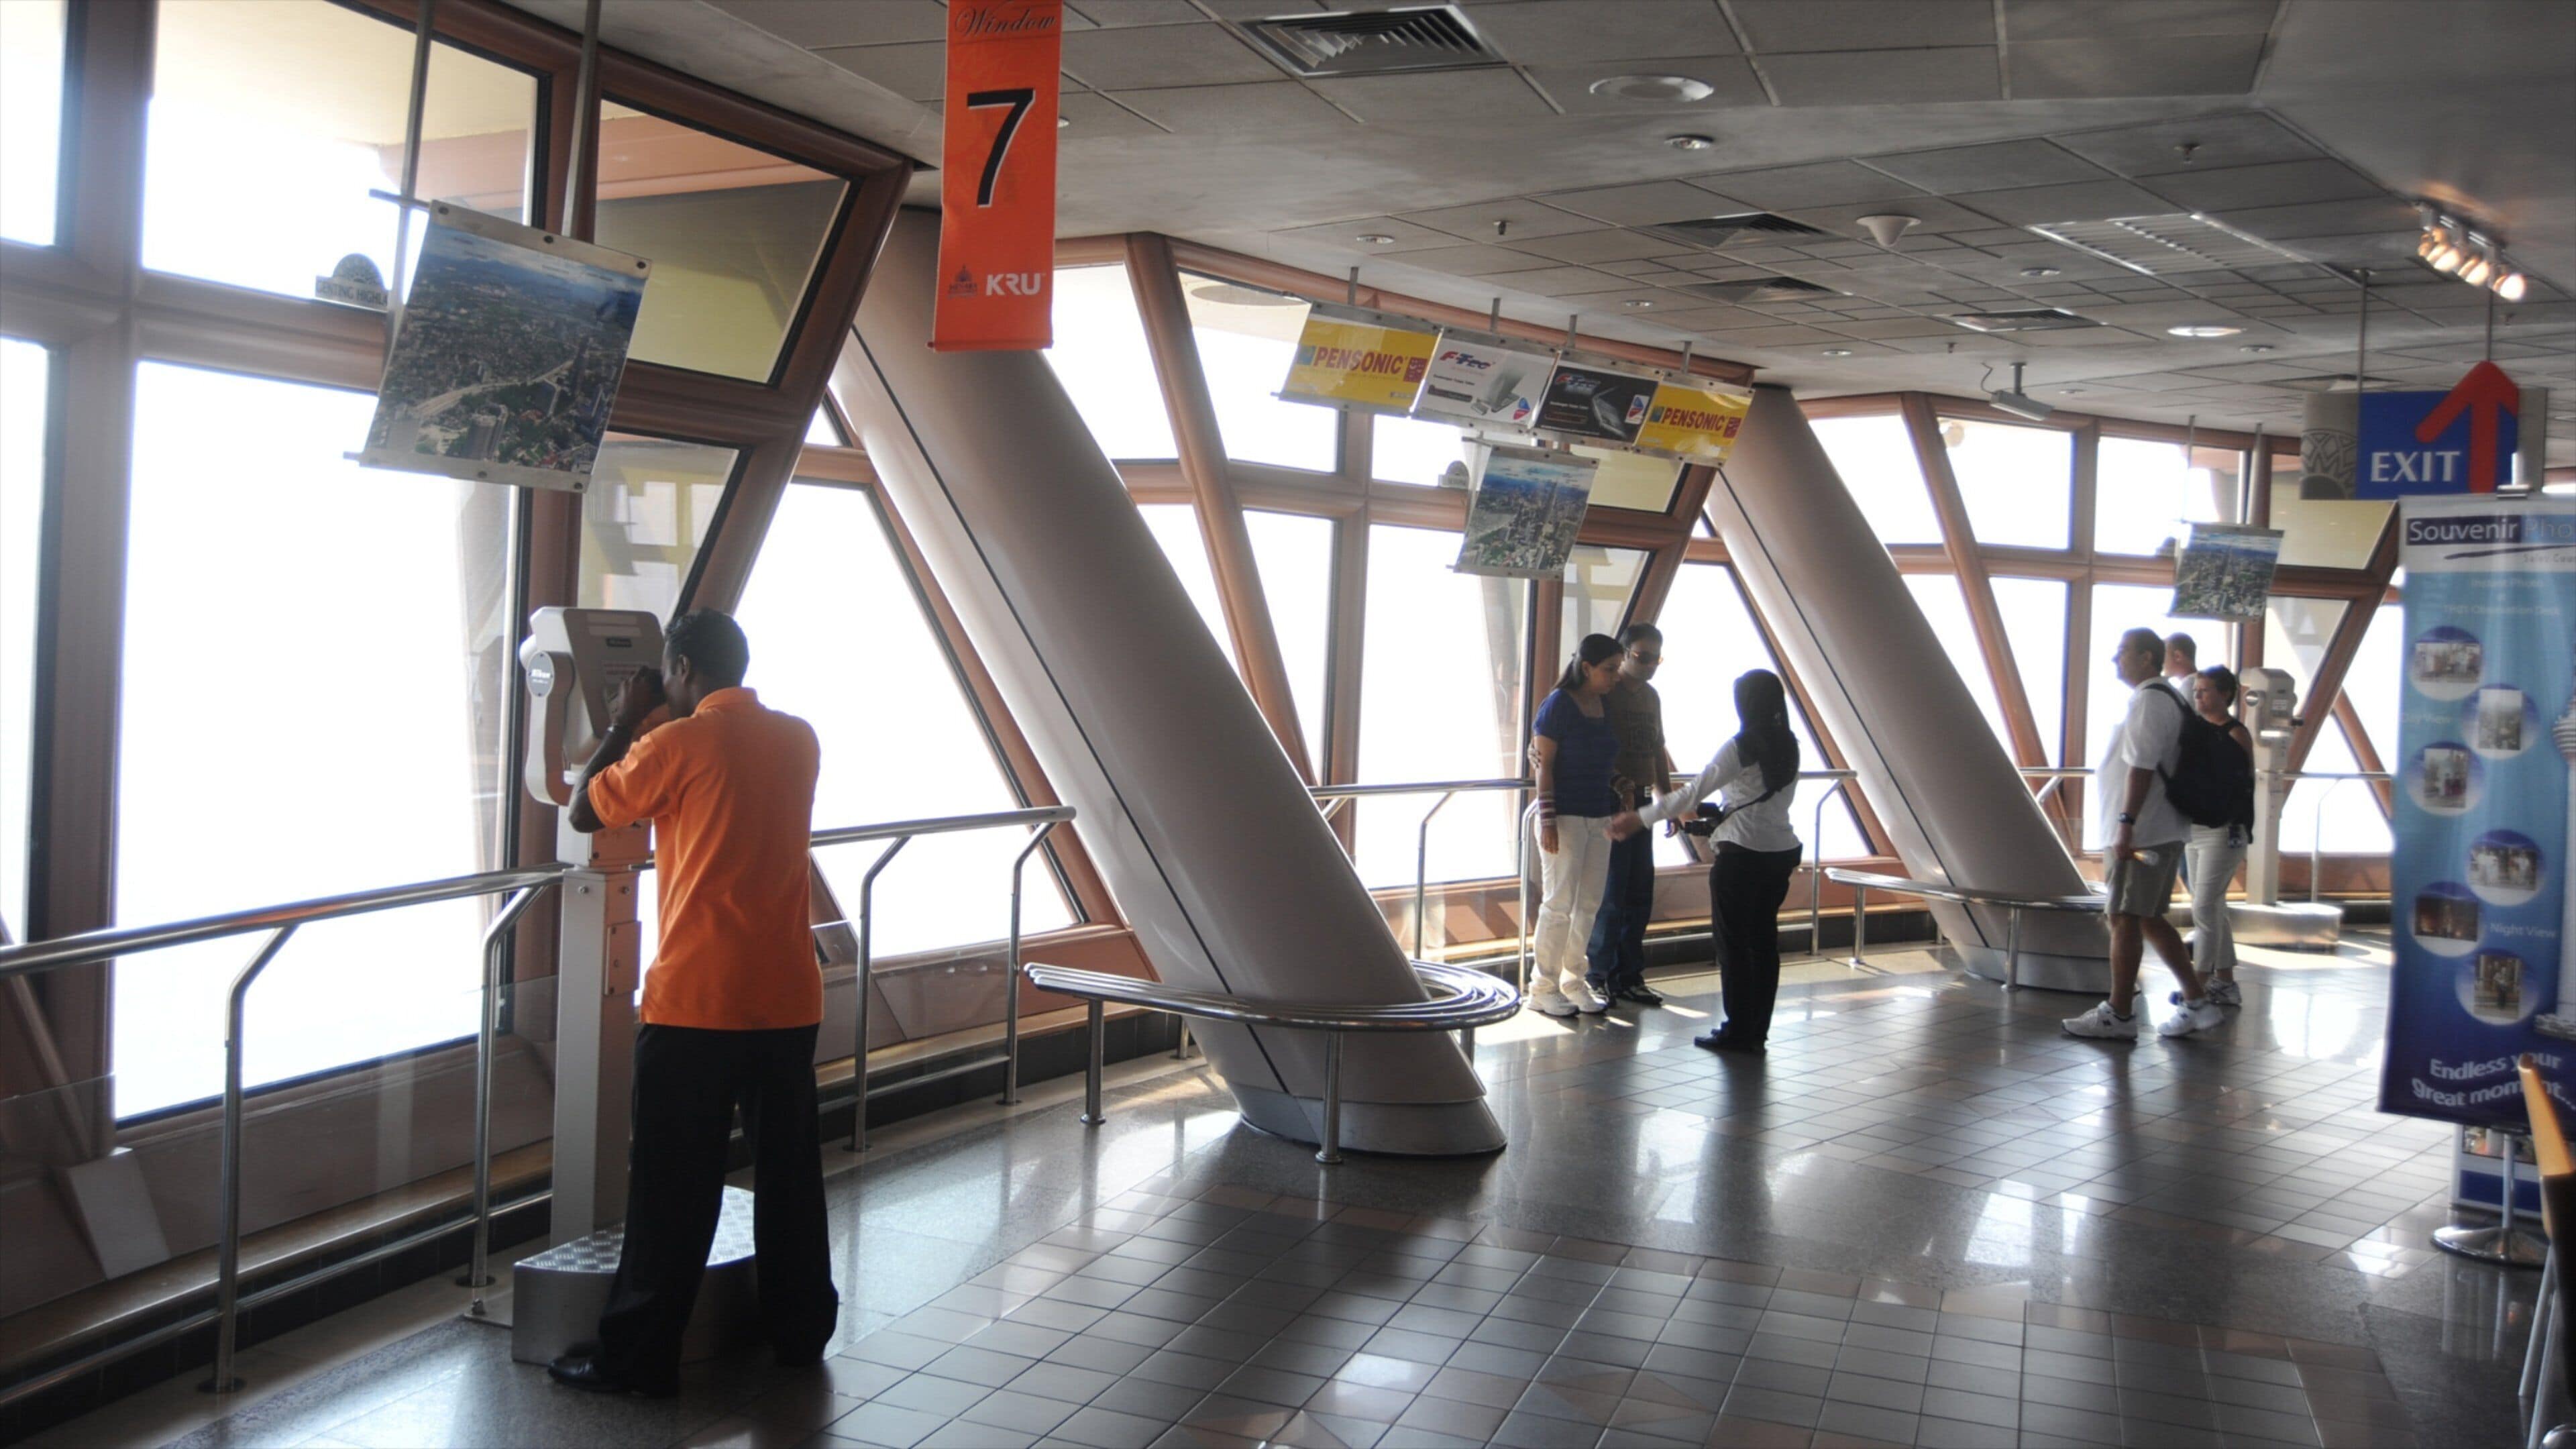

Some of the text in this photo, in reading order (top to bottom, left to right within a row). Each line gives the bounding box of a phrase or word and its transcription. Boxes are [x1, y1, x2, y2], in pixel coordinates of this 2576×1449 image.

[955, 7, 1056, 37] Window
[967, 88, 1036, 208] 7
[985, 272, 1042, 296] KRU
[1313, 345, 1403, 374] PENSONIC
[1660, 407, 1725, 431] PENSONIC
[2370, 451, 2461, 482] EXIT
[2409, 519, 2518, 541] Souvenir
[2490, 922, 2556, 938] Night View
[2430, 1053, 2562, 1079] Endless yur
[2412, 1077, 2466, 1106] great
